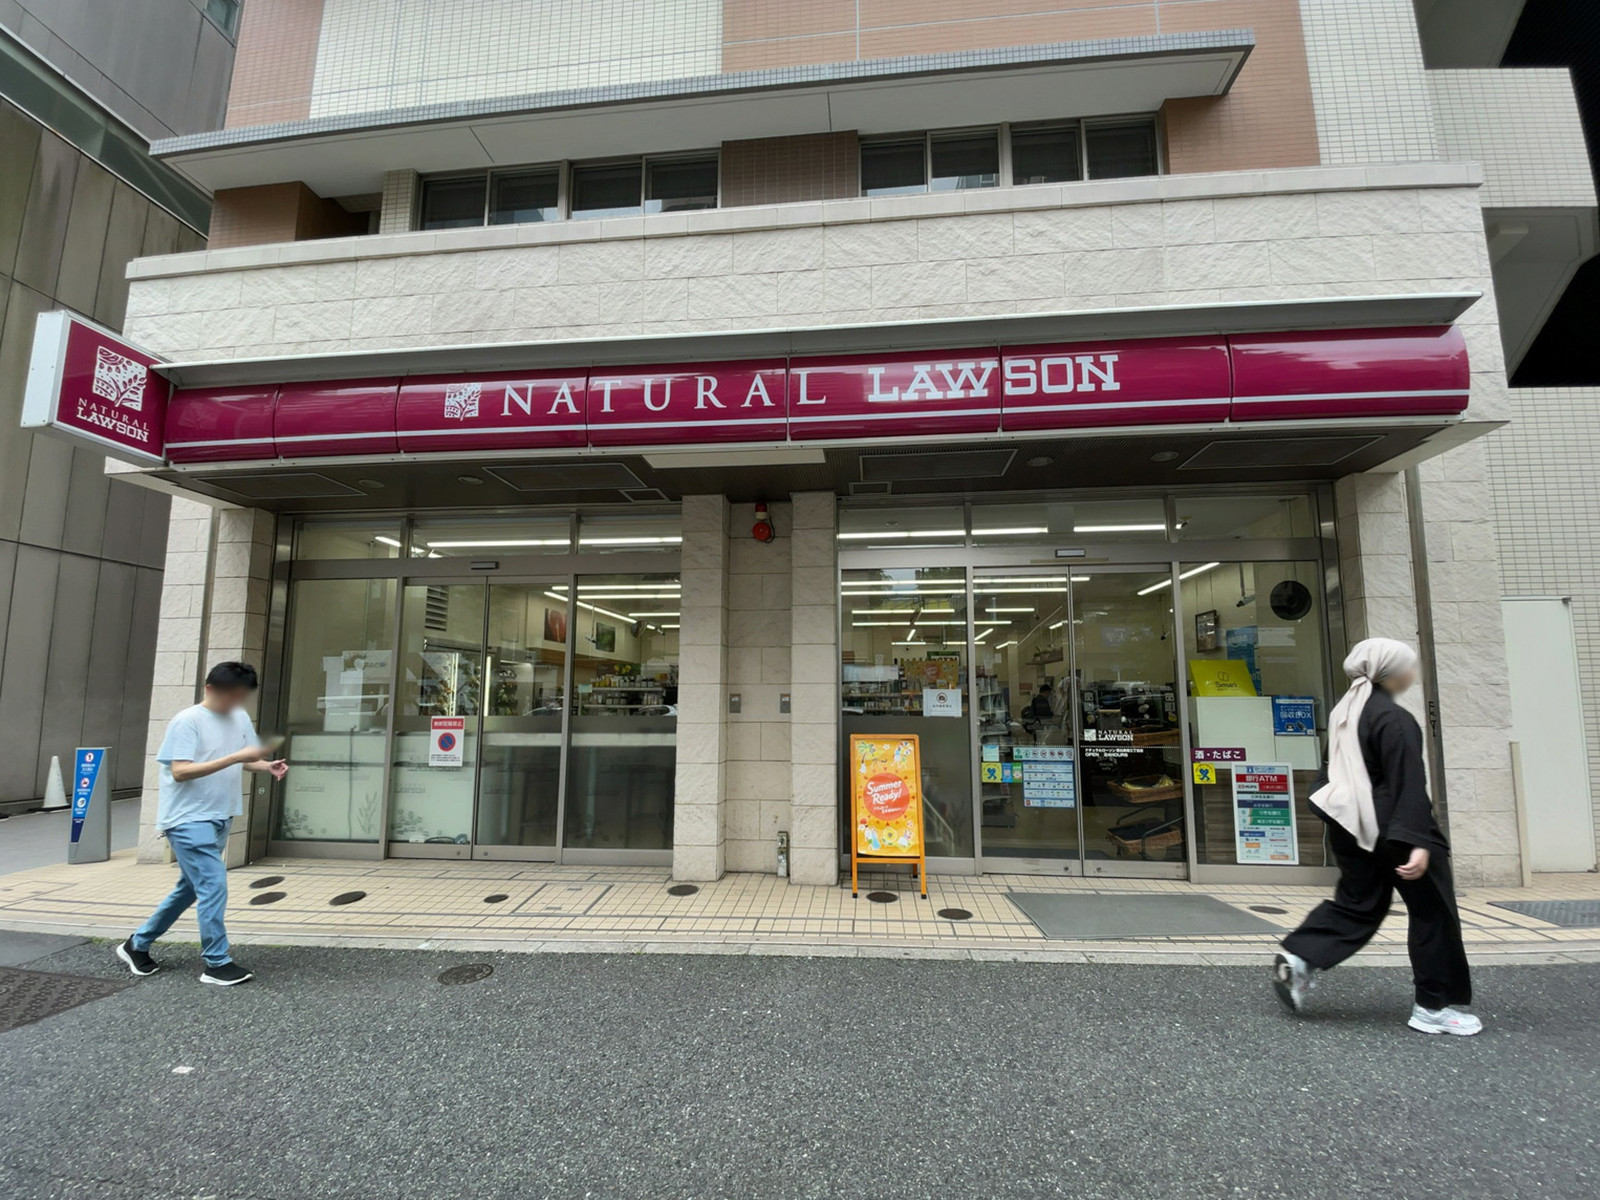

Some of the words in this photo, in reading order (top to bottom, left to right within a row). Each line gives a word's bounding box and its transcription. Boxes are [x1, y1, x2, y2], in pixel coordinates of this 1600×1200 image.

[500, 372, 827, 417] NATURAL
[867, 354, 1121, 403] LAWSON
[78, 397, 149, 432] NATURAL
[76, 406, 149, 443] LAWSON
[1195, 750, 1242, 760] 酒・たばこ
[866, 780, 903, 795] Summer
[1245, 775, 1278, 783] 銀行ATM
[871, 788, 903, 805] Ready!
